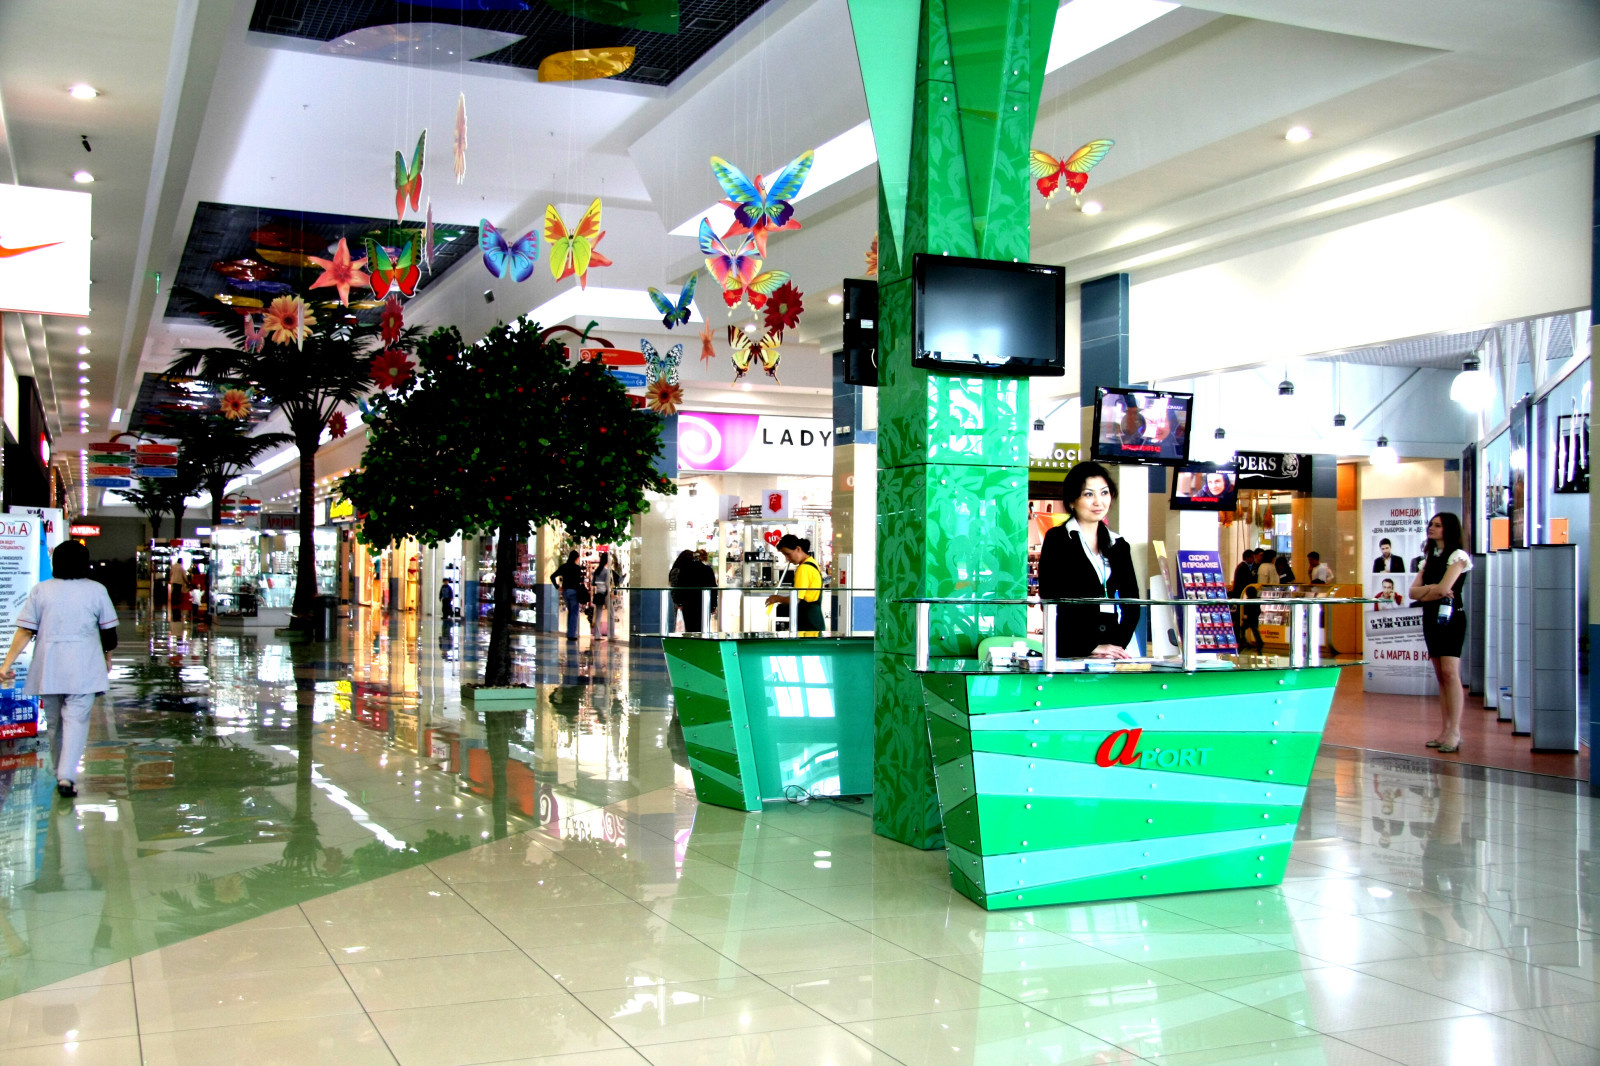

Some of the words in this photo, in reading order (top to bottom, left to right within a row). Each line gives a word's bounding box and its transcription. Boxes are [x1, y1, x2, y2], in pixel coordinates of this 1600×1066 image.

[762, 428, 832, 447] LADY
[1030, 460, 1072, 469] FRANCE
[1395, 614, 1424, 622] ГОВОР
[1371, 619, 1424, 630] МУЖЧИН
[1386, 650, 1411, 661] МАРТА
[1413, 650, 1419, 661] В
